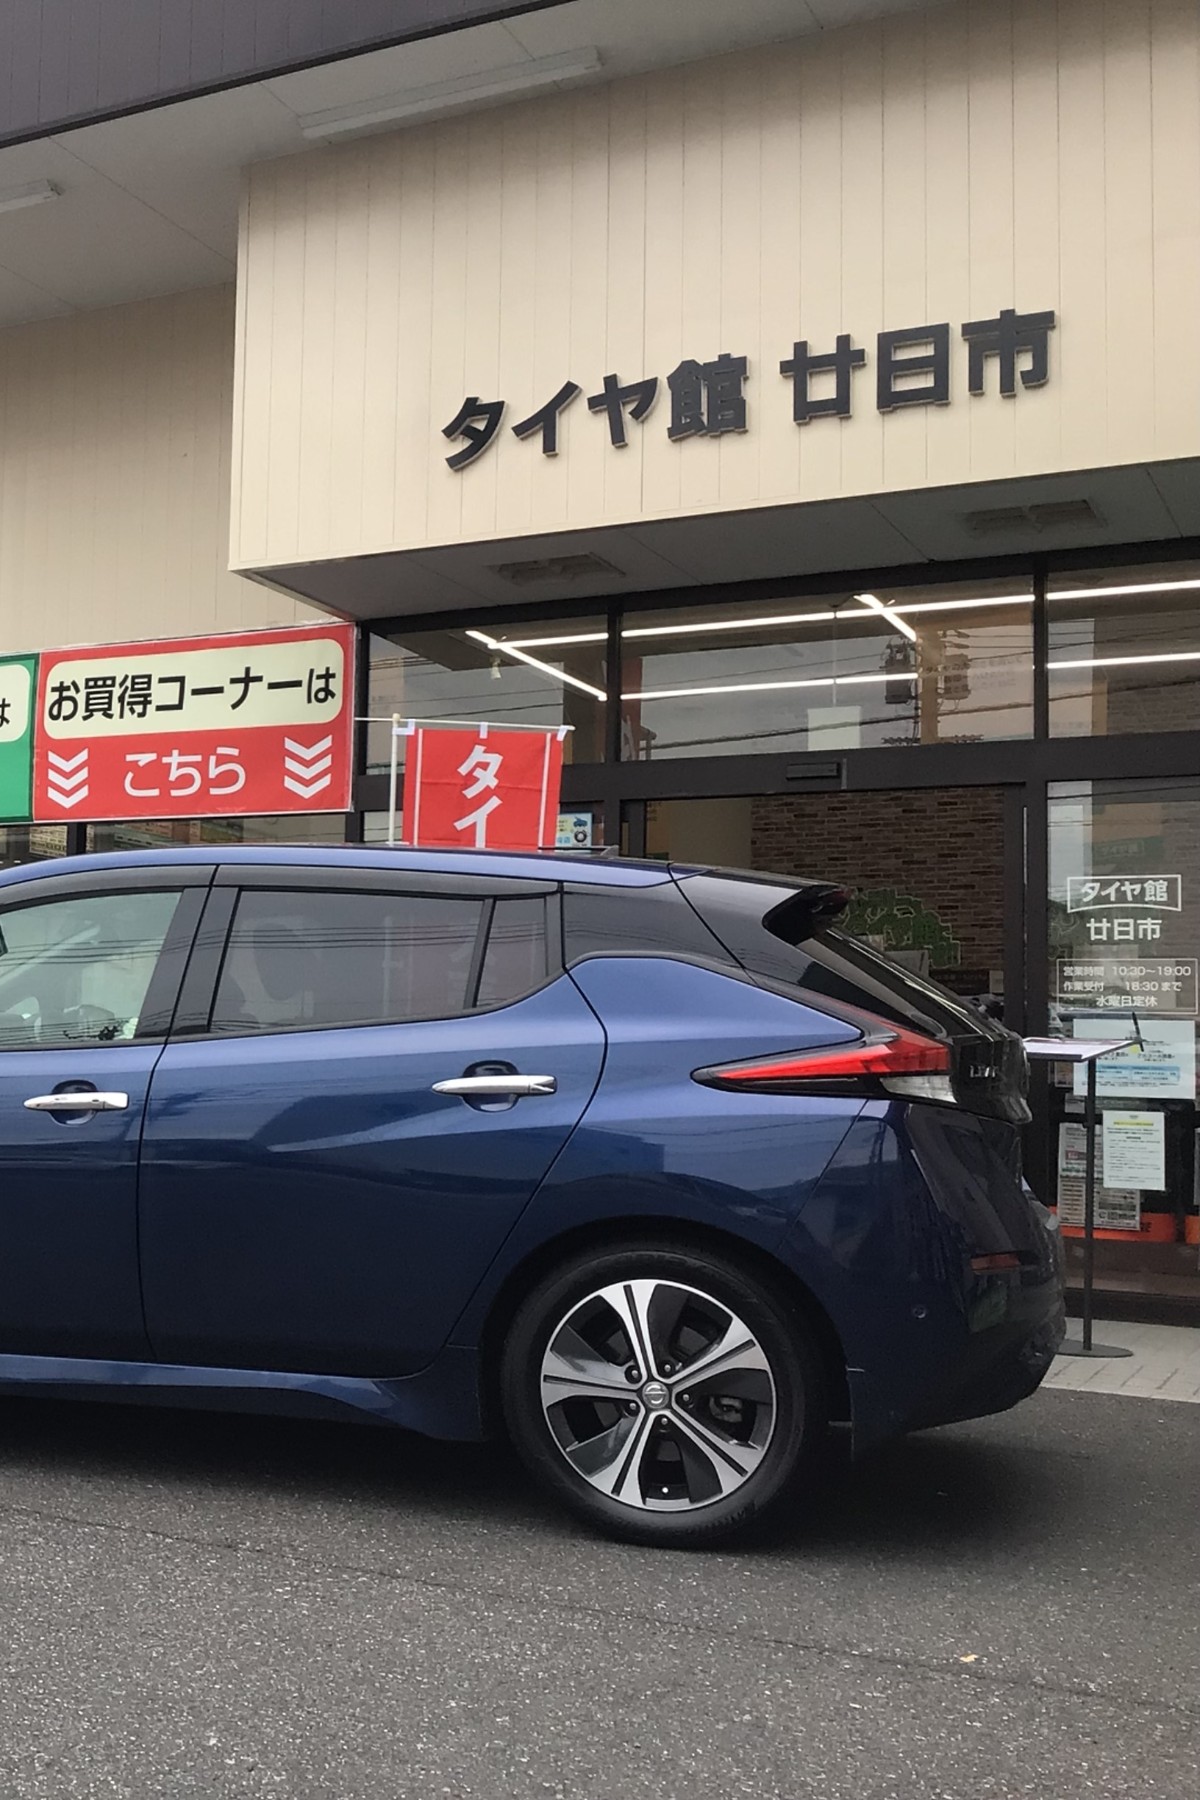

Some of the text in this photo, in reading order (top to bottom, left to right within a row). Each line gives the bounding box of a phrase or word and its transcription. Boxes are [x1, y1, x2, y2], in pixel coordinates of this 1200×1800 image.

[441, 309, 1055, 471] タイヤ館 廿日市
[48, 666, 337, 722] お買得コーナーは
[122, 746, 247, 797] こちら
[453, 744, 503, 848] タイ
[1081, 879, 1168, 902] タイヤ館
[1086, 918, 1162, 940] 廿日市
